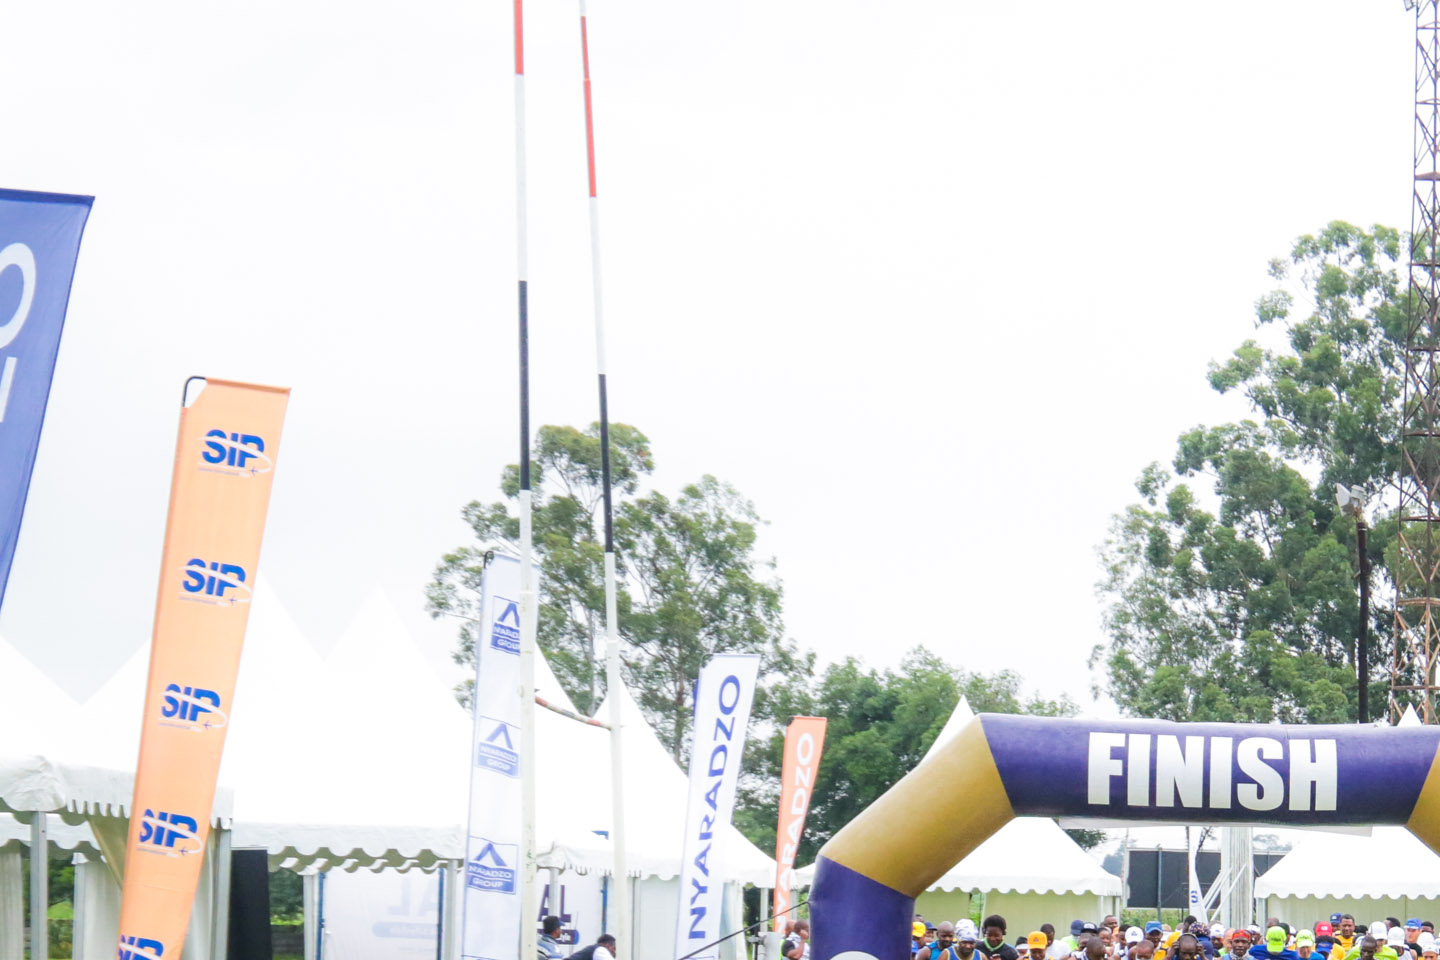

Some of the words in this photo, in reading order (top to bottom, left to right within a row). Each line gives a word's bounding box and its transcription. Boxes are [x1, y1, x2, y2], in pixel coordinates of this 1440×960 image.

[202, 429, 265, 468] SIP
[182, 558, 246, 597] SIP
[161, 684, 221, 722] SIP
[1087, 731, 1338, 812] FINISH
[688, 675, 741, 940] NYARADZO
